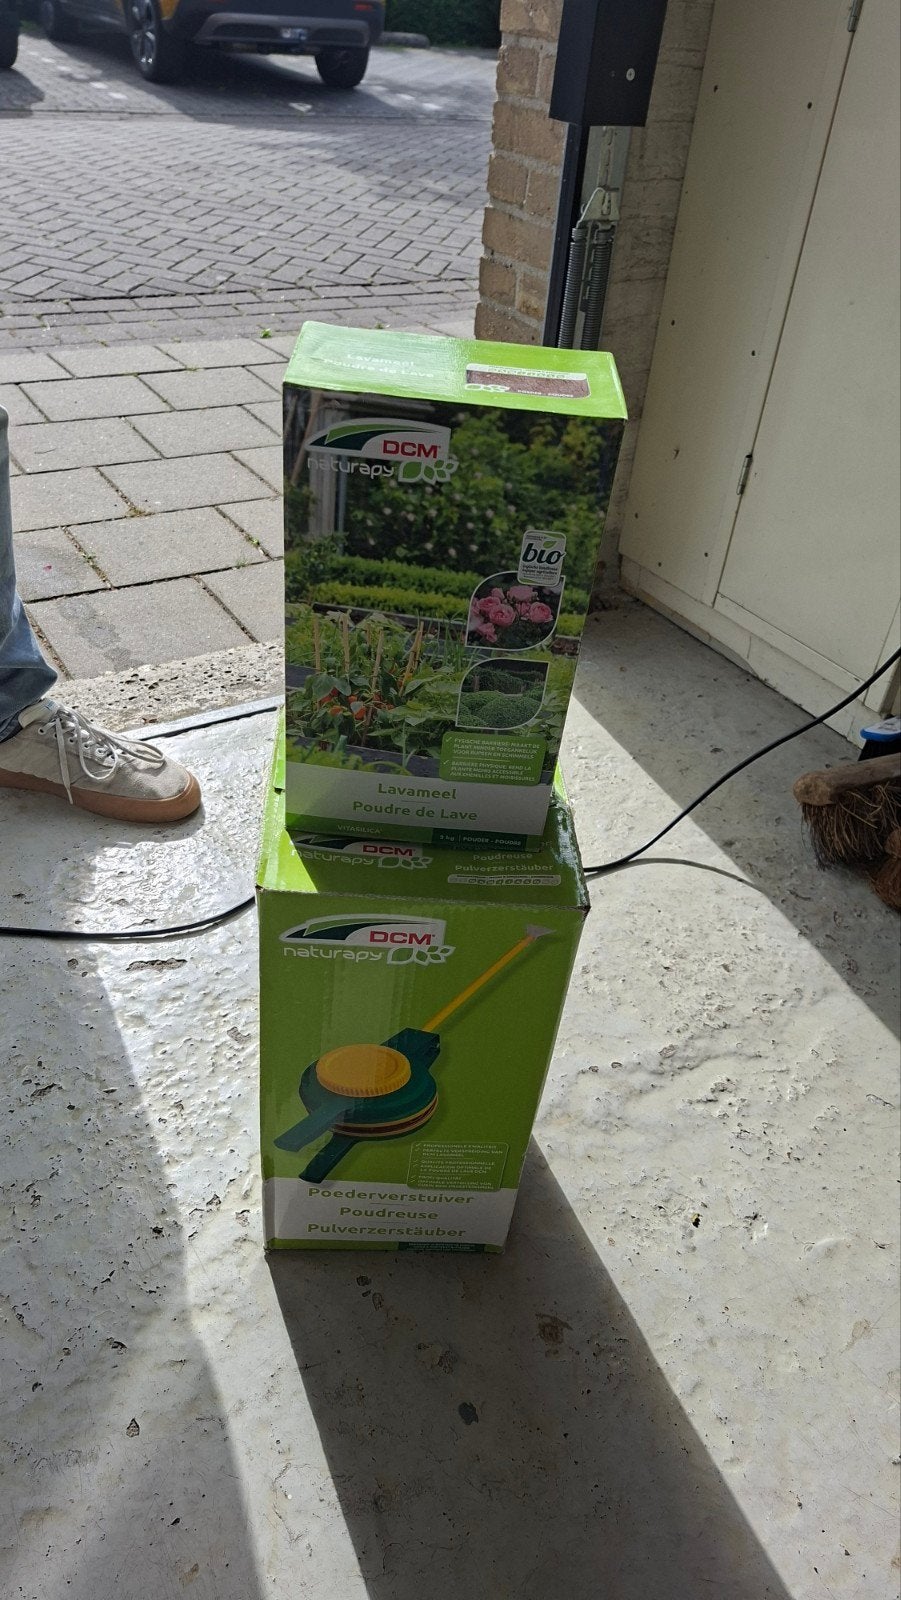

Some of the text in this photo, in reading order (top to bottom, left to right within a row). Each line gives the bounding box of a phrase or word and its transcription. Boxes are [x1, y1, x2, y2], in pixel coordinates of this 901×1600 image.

[383, 440, 439, 459] DCM
[307, 457, 395, 479] naturapy
[522, 543, 566, 565] bio
[377, 783, 457, 800] Lavameel
[352, 801, 478, 821] Poudre de Lave
[291, 849, 375, 865] naturapy
[362, 845, 413, 856] DCM
[473, 853, 533, 861] Poudreuse
[455, 864, 554, 872] Pulverzerstäuber
[369, 930, 432, 946] DCM
[284, 946, 383, 963] naturapy
[308, 1187, 475, 1204] Poederverstuiver
[340, 1207, 439, 1220] Poudreuse
[307, 1223, 467, 1237] Pulverzerstäuber
